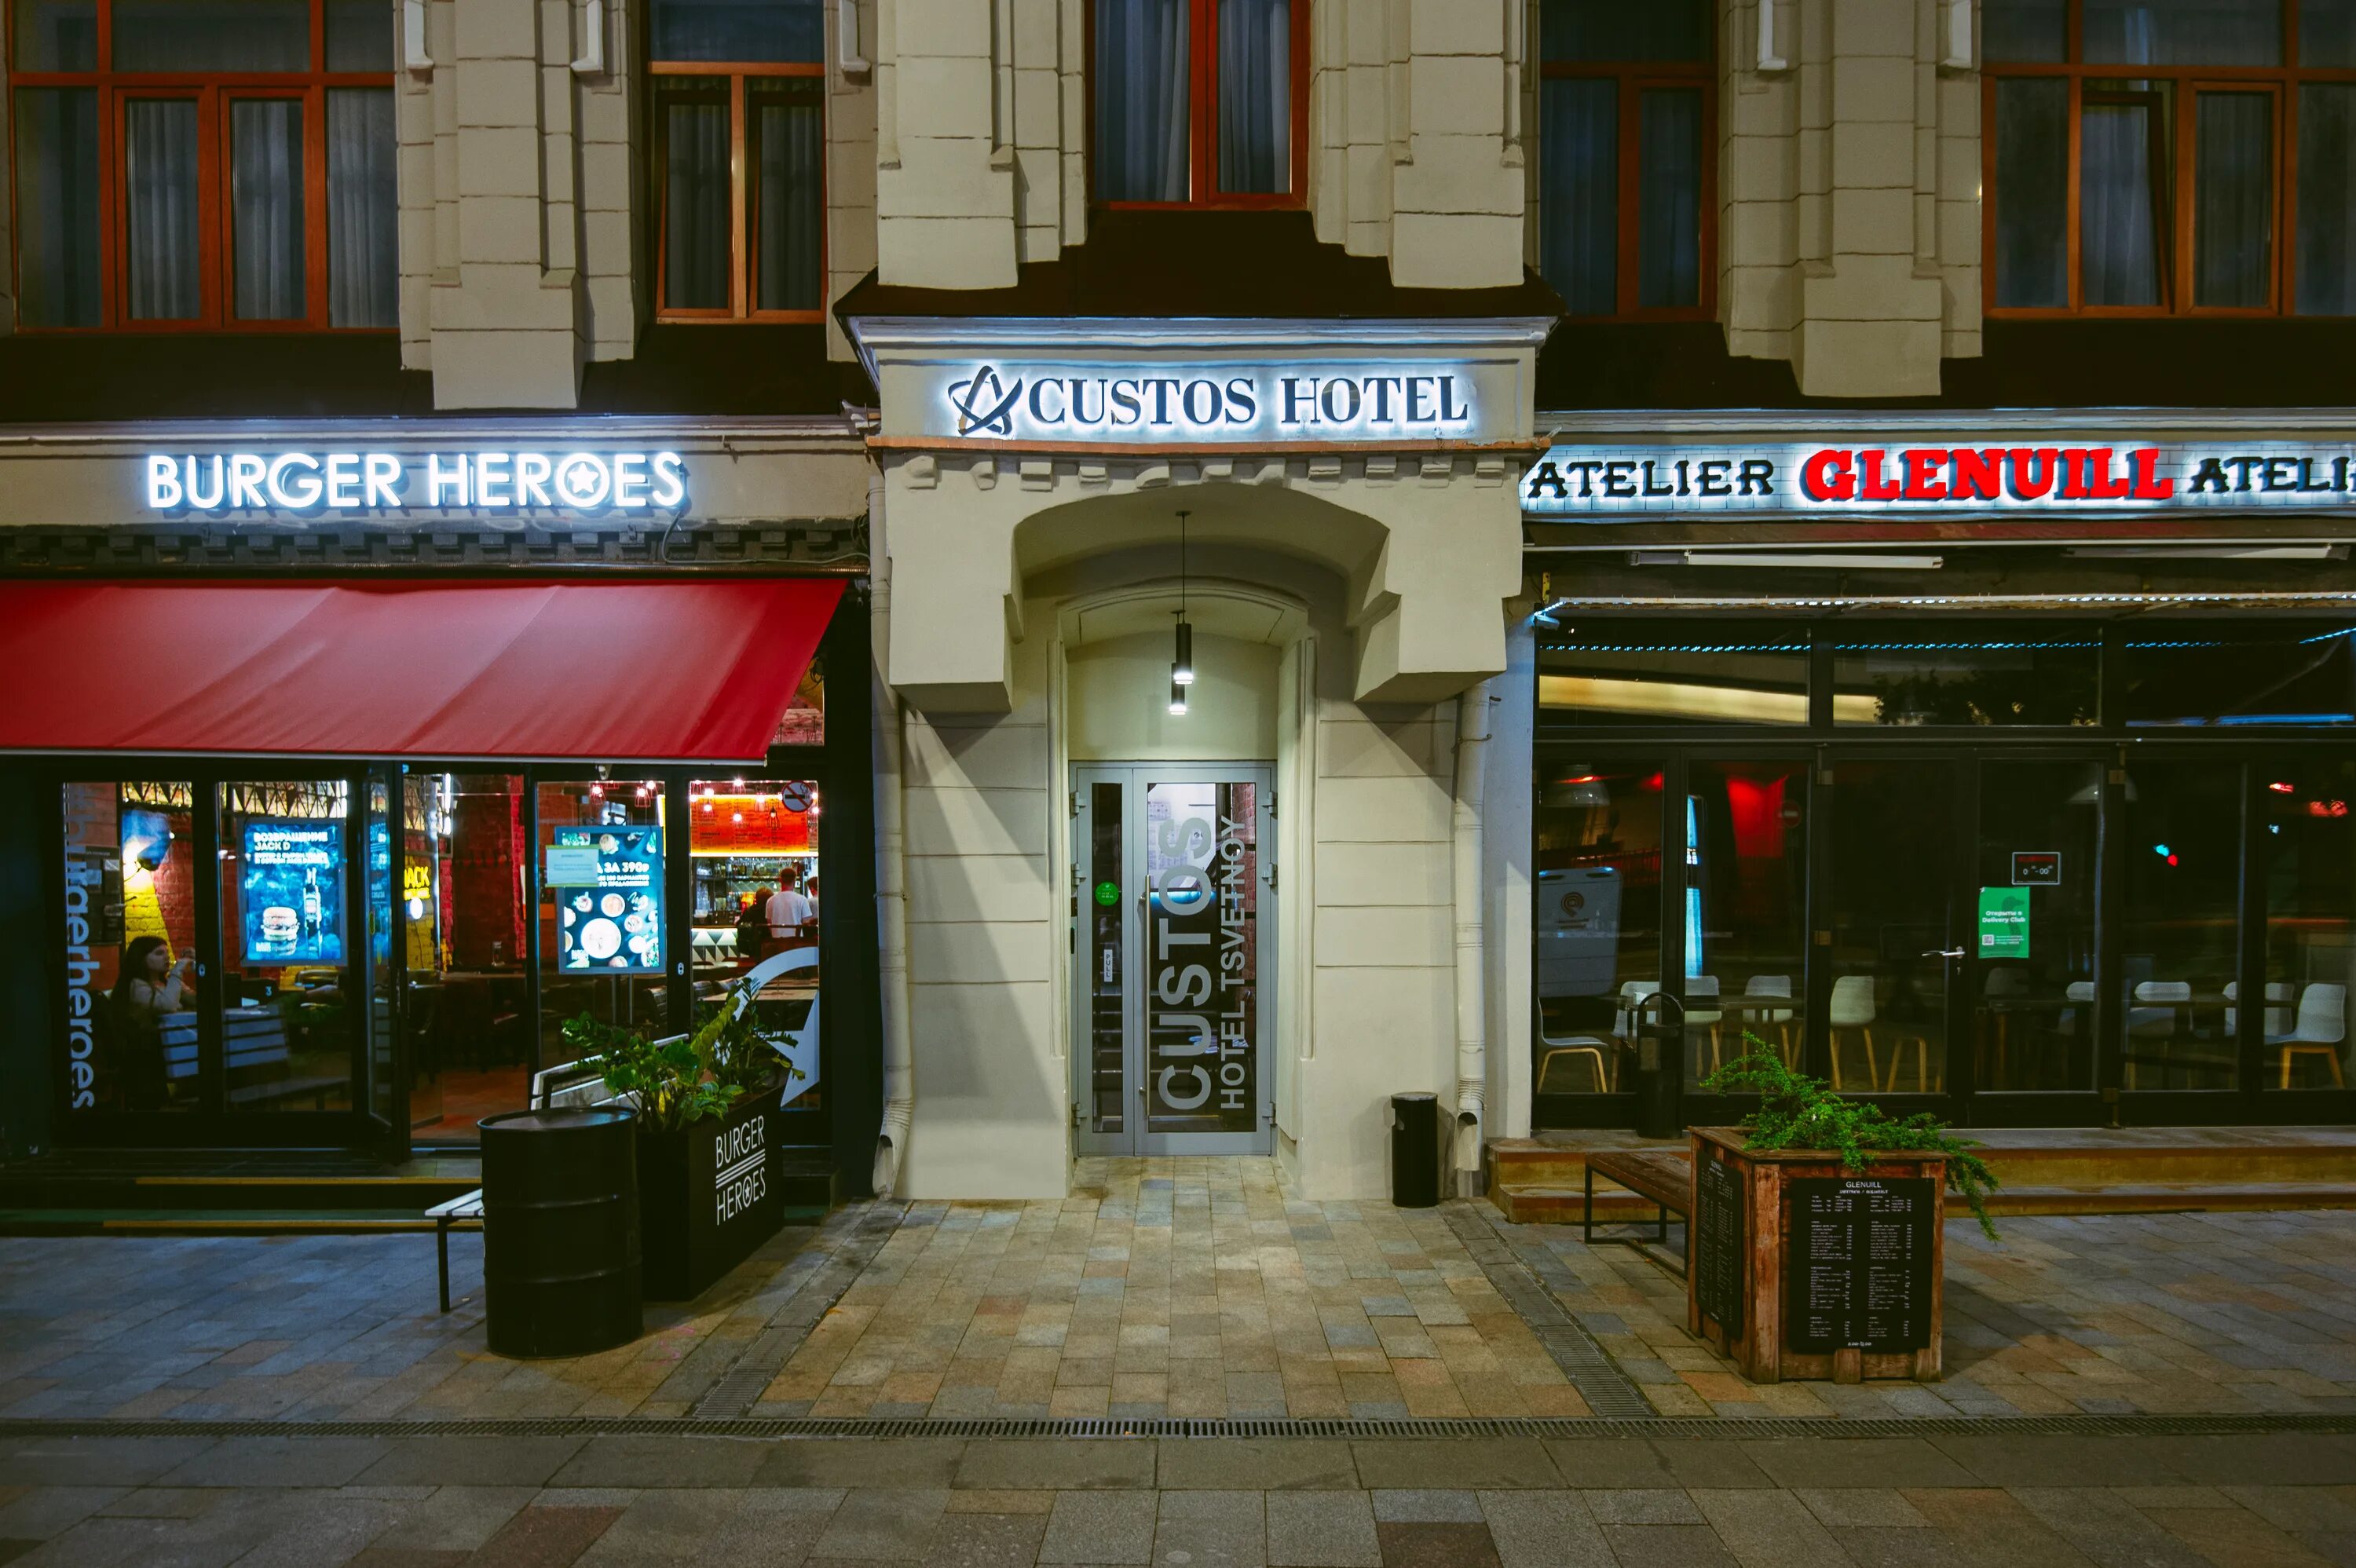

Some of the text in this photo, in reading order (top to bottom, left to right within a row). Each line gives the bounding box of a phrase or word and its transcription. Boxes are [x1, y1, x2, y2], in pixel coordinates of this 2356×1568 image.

[1029, 375, 1469, 425] CUSTOS HOTEL
[148, 451, 684, 510] BURGER HEROES
[1527, 448, 2356, 501] ATELIER GLENUILL ATELI
[1158, 817, 1212, 1109] CUSTOS
[1220, 815, 1246, 1109] HOTEL TSVETNOY
[715, 1115, 765, 1168] BURGER
[716, 1167, 766, 1226] HEROES
